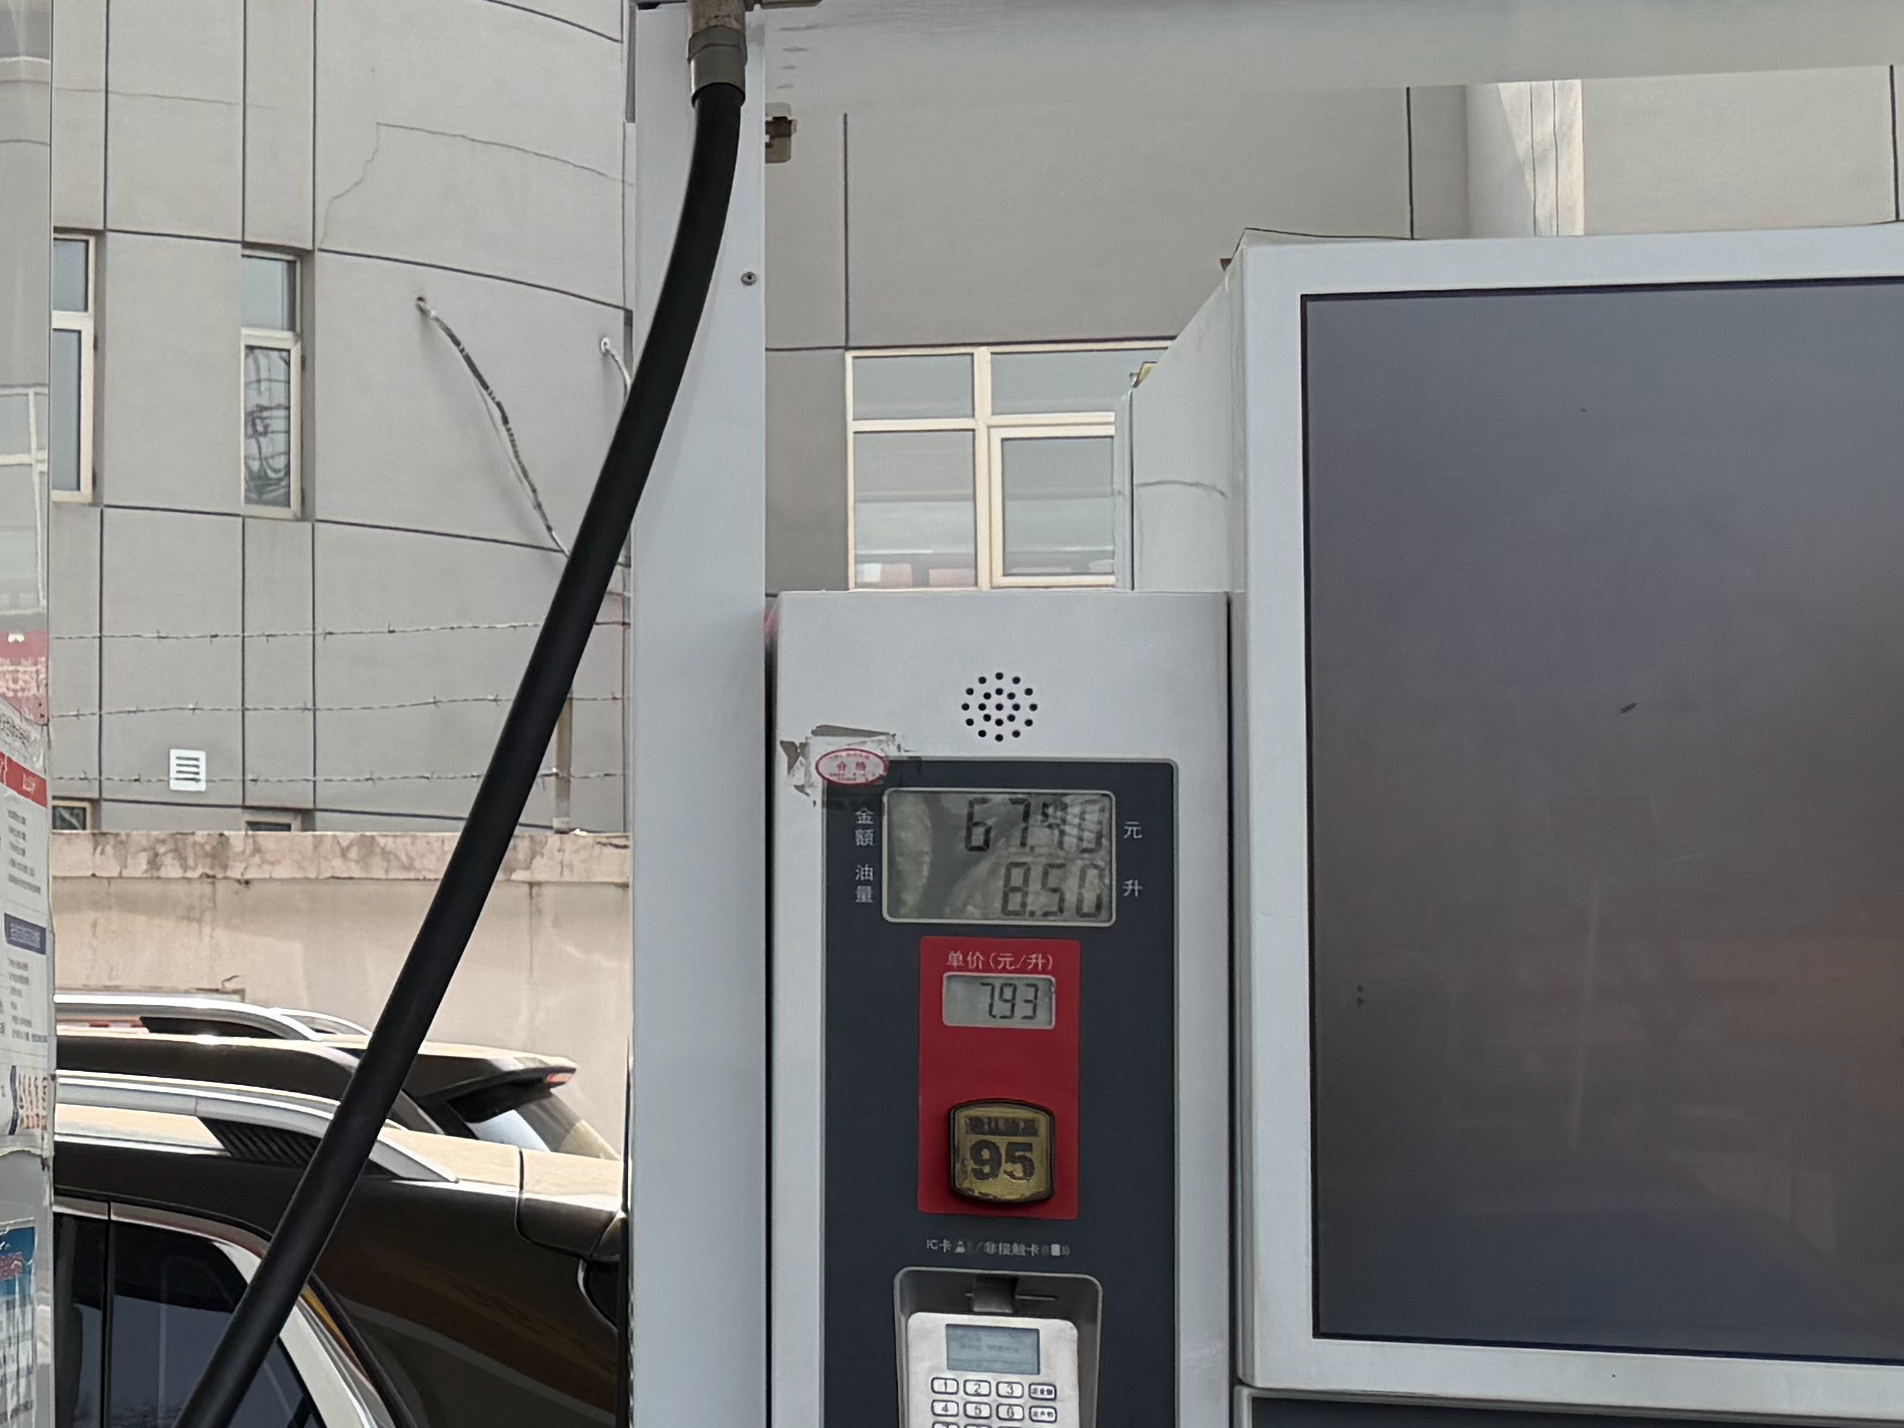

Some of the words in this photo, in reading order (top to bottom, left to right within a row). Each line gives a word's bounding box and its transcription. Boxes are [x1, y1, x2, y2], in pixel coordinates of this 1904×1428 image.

[1123, 822, 1142, 839] 元
[1001, 862, 1103, 917] 8.50
[1123, 880, 1142, 897] 升
[968, 1139, 1036, 1182] 95
